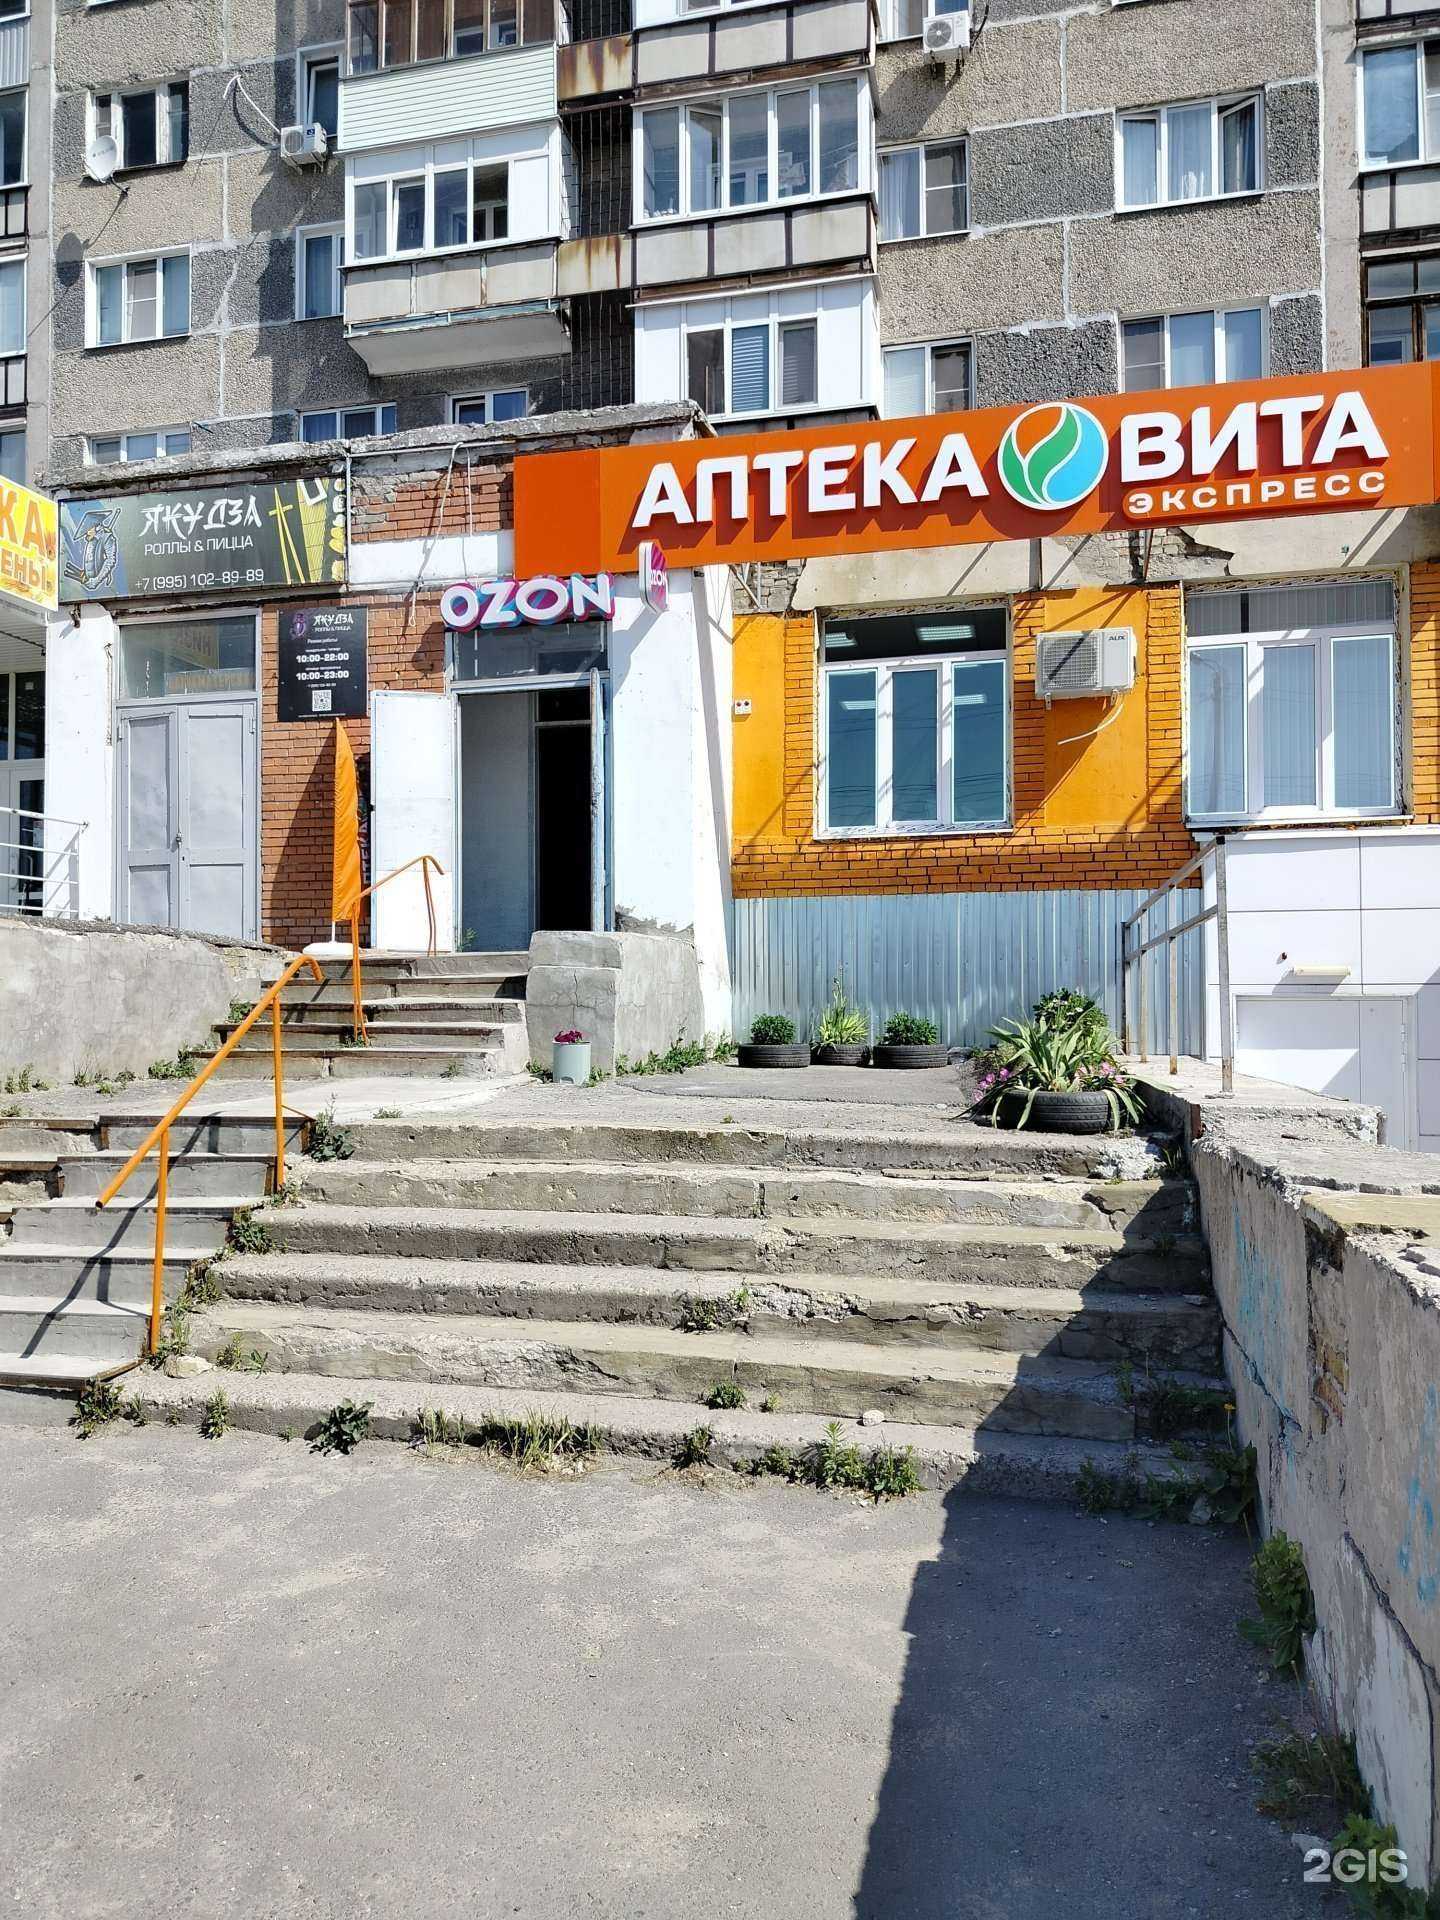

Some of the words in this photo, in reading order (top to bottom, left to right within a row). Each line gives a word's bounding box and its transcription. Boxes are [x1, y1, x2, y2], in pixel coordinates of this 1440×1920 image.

[632, 432, 989, 528] АПТЕКА
[1120, 390, 1391, 484] ВИТА
[1128, 471, 1386, 514] ЭКСПРЕСС
[138, 494, 263, 540] ЯКУДЗА
[144, 541, 192, 556] РОЛЛЫ
[193, 540, 205, 552] &
[206, 535, 255, 552] ПИЦЦА
[153, 575, 187, 590] (995)
[190, 568, 265, 586] 102-89-89
[440, 571, 615, 630] OZON
[312, 613, 354, 627] ЯКУДЗА
